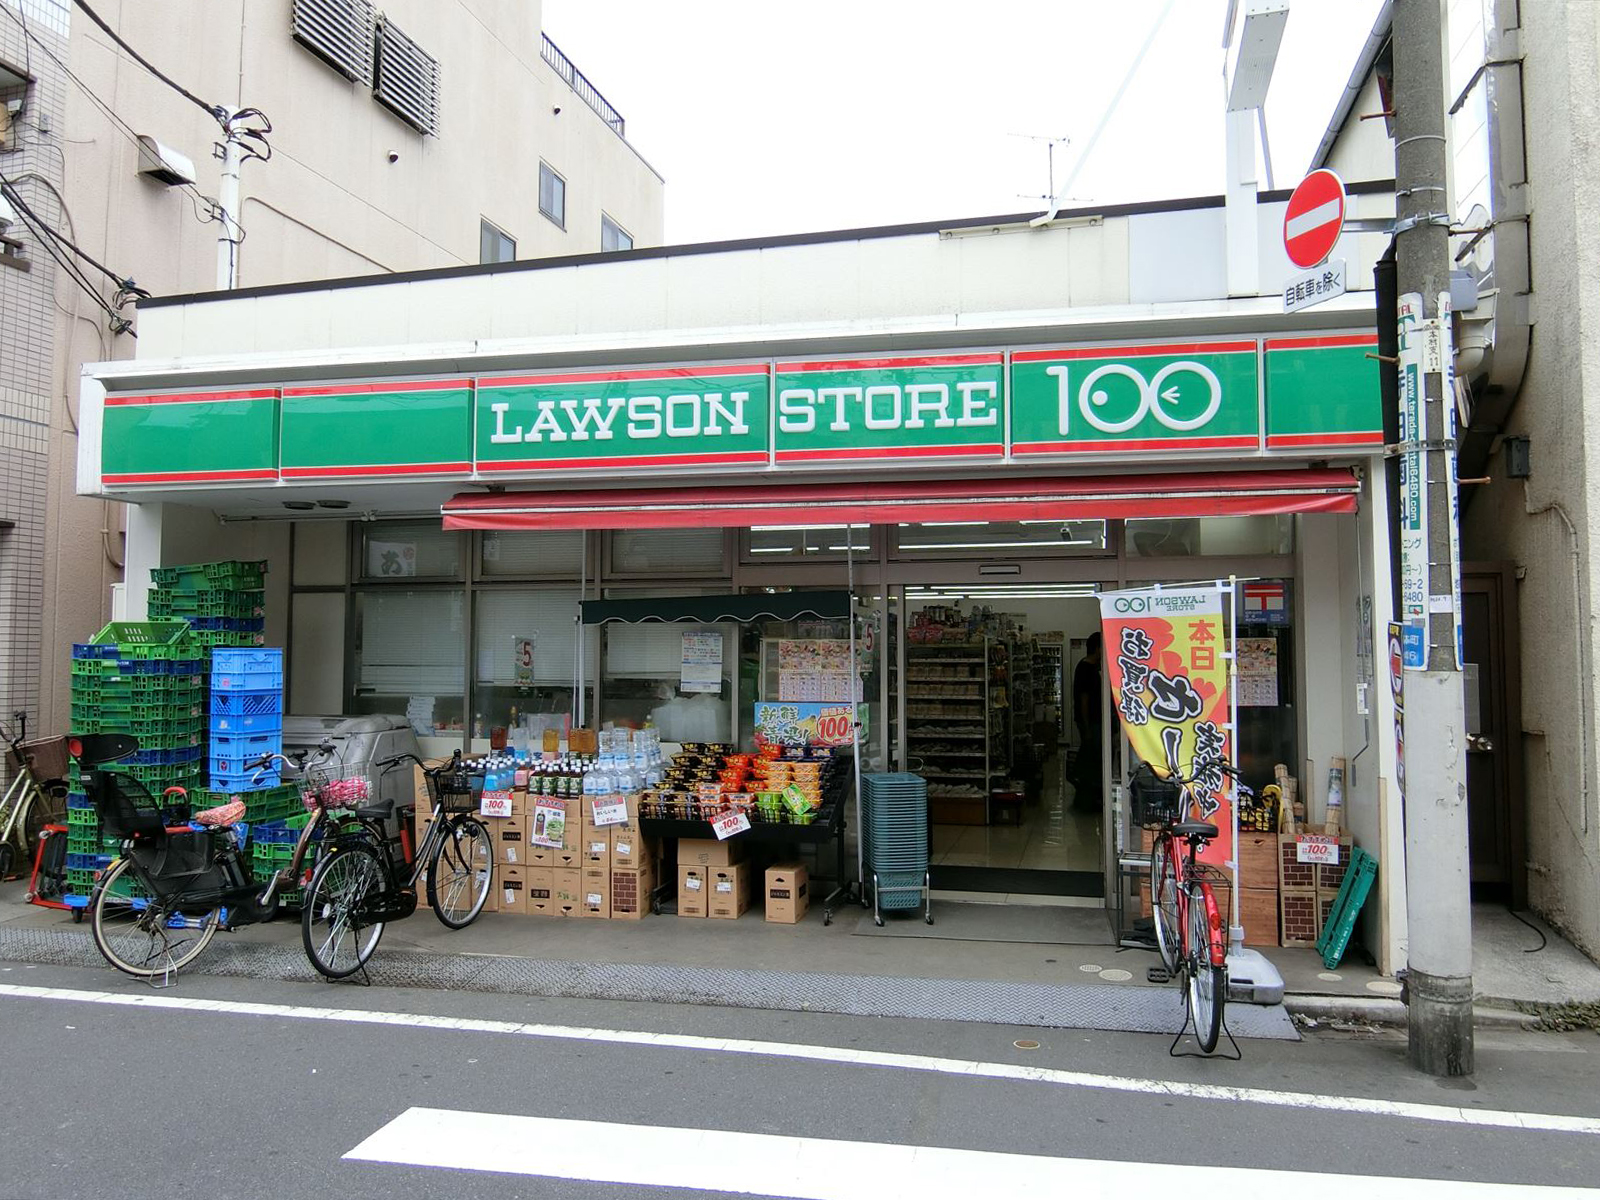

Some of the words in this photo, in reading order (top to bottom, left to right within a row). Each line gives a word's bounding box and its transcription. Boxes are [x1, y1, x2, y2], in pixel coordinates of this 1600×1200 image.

[1286, 271, 1340, 306] 自転車を除く
[491, 392, 749, 443] LAWSON
[779, 381, 997, 432] STORE
[1046, 361, 1221, 436] 100
[1408, 372, 1418, 521] www.terada-ntal6480.com
[760, 705, 798, 723] 新鮮
[488, 800, 504, 809] 100
[722, 817, 739, 829] 100
[1307, 844, 1328, 854] 100
